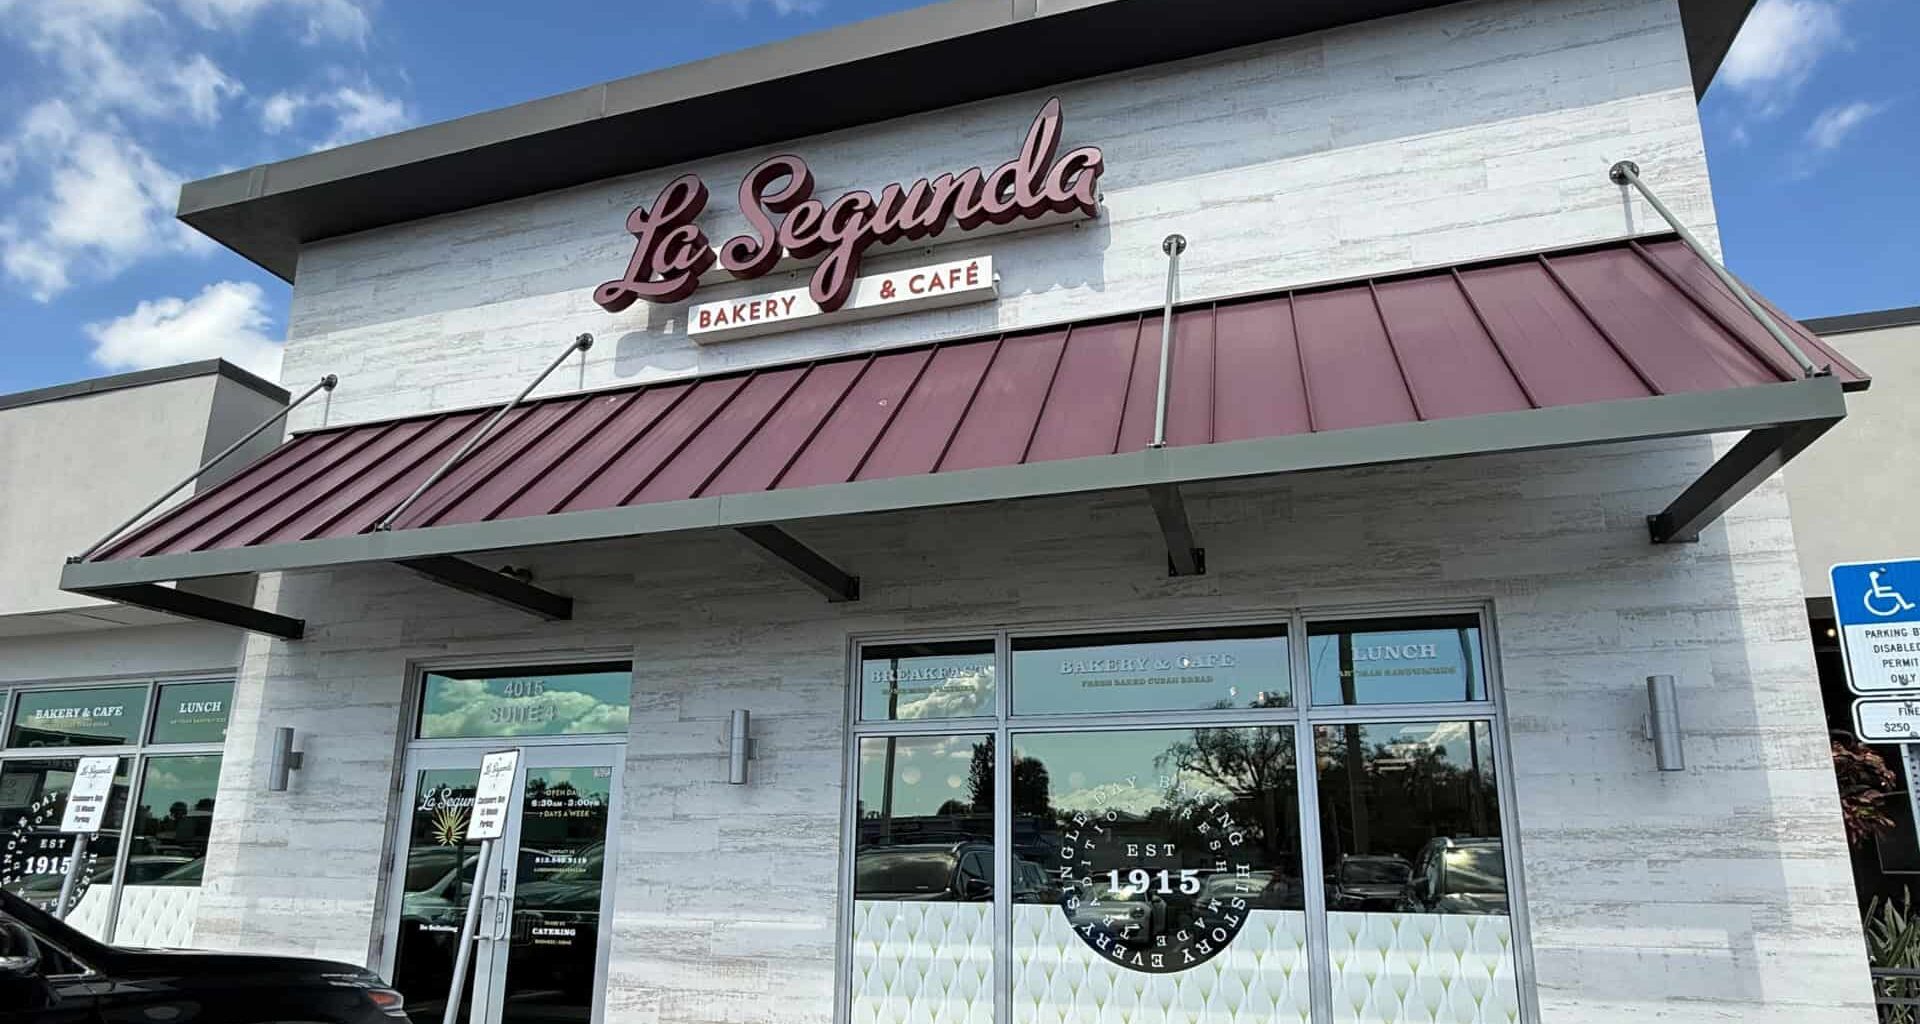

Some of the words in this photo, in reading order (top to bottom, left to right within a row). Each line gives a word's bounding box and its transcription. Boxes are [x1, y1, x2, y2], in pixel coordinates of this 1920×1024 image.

[593, 173, 717, 313] La
[719, 96, 1105, 314] Segunda
[699, 293, 798, 330] BAKERY
[879, 279, 898, 301] &
[908, 260, 980, 297] CAFÉ
[1864, 627, 1908, 639] PARKING
[1351, 643, 1437, 662] LUNCH
[1872, 642, 1920, 654] DISABLED
[1061, 657, 1149, 675] BAKERY
[1882, 657, 1919, 669] PERMIT
[871, 664, 986, 684] BREAKFAST
[1890, 673, 1916, 684] ONLY
[504, 679, 544, 697] 4015
[35, 707, 81, 720] BAKERY
[81, 707, 91, 718] &
[179, 701, 222, 714] LUNCH
[489, 705, 544, 724] SUITE
[1883, 721, 1911, 733] $250
[32, 791, 58, 813] DAY
[418, 787, 436, 811] La
[437, 787, 475, 816] Segun
[40, 838, 66, 849] EST
[1126, 843, 1176, 858] EST
[24, 856, 73, 875] 1915
[1060, 811, 1089, 910] SINGLE
[1106, 868, 1201, 895] 1915
[1182, 863, 1251, 965] HISTORY
[532, 926, 577, 937] CATERING
[1081, 921, 1165, 969] EVERY
